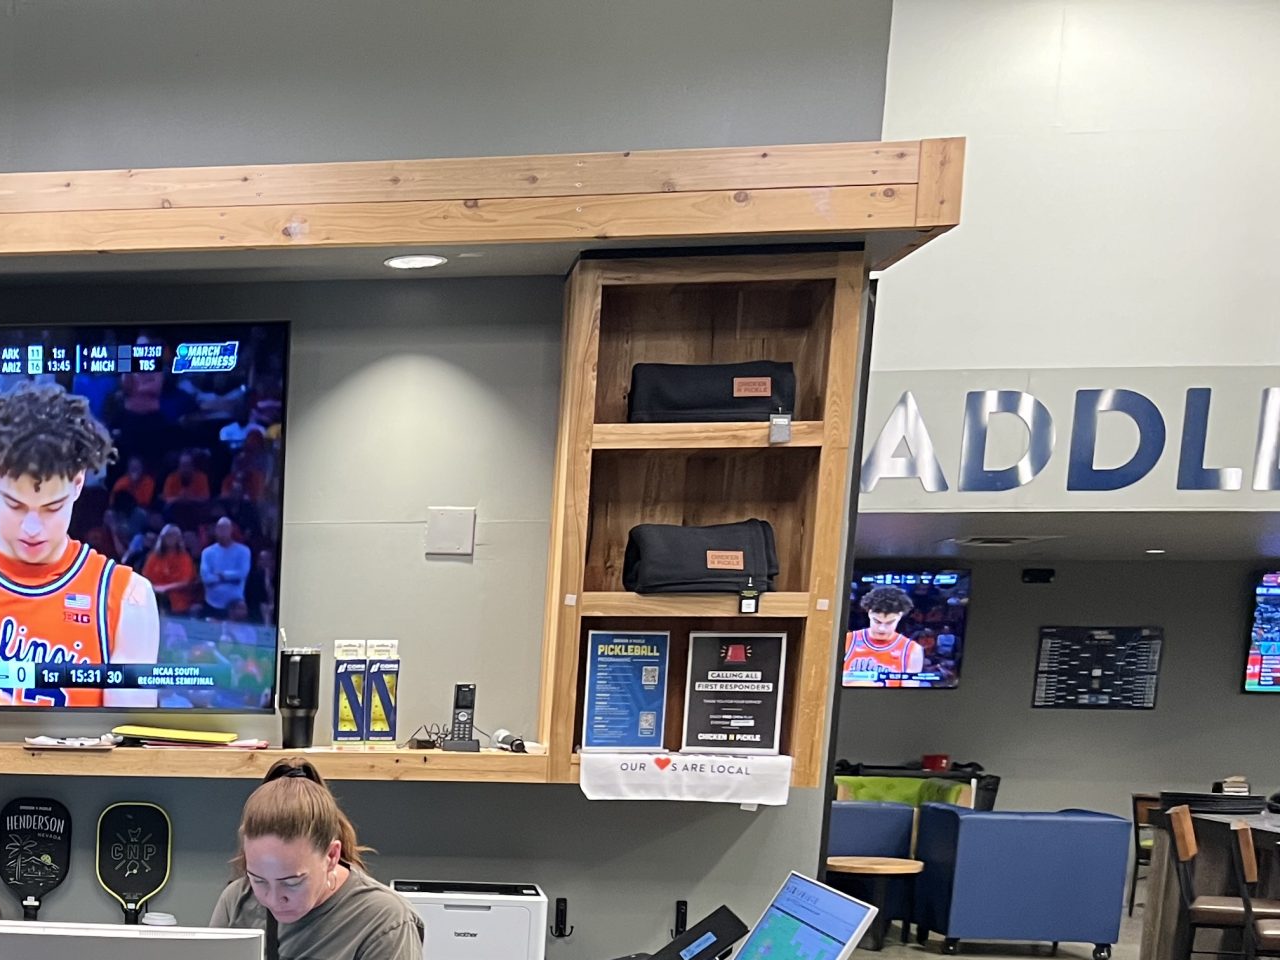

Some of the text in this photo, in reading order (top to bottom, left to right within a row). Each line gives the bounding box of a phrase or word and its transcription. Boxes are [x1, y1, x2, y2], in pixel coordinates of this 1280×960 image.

[2, 348, 20, 360] ARK
[31, 349, 40, 357] 11
[83, 347, 107, 359] 4 ALA
[187, 345, 221, 356] MARCH
[2, 362, 21, 373] ARIZ
[31, 362, 40, 371] 16
[47, 360, 71, 372] 13:45
[90, 360, 115, 372] MICH
[139, 359, 155, 371] TBS
[191, 356, 235, 367] MADNESS
[597, 644, 660, 656] PICKLEBALL
[70, 669, 101, 682] 15:31
[107, 671, 122, 683] 30
[152, 667, 199, 676] NCAA SOUTH
[710, 672, 759, 680] CALLING ALL
[137, 676, 214, 686] REGIONAL SEMIFINAL
[719, 683, 771, 691] RESPONDERS
[620, 762, 751, 776] OUR S ARE LOCAL
[6, 814, 65, 835] HENDERSON
[37, 832, 62, 841] NEVADA
